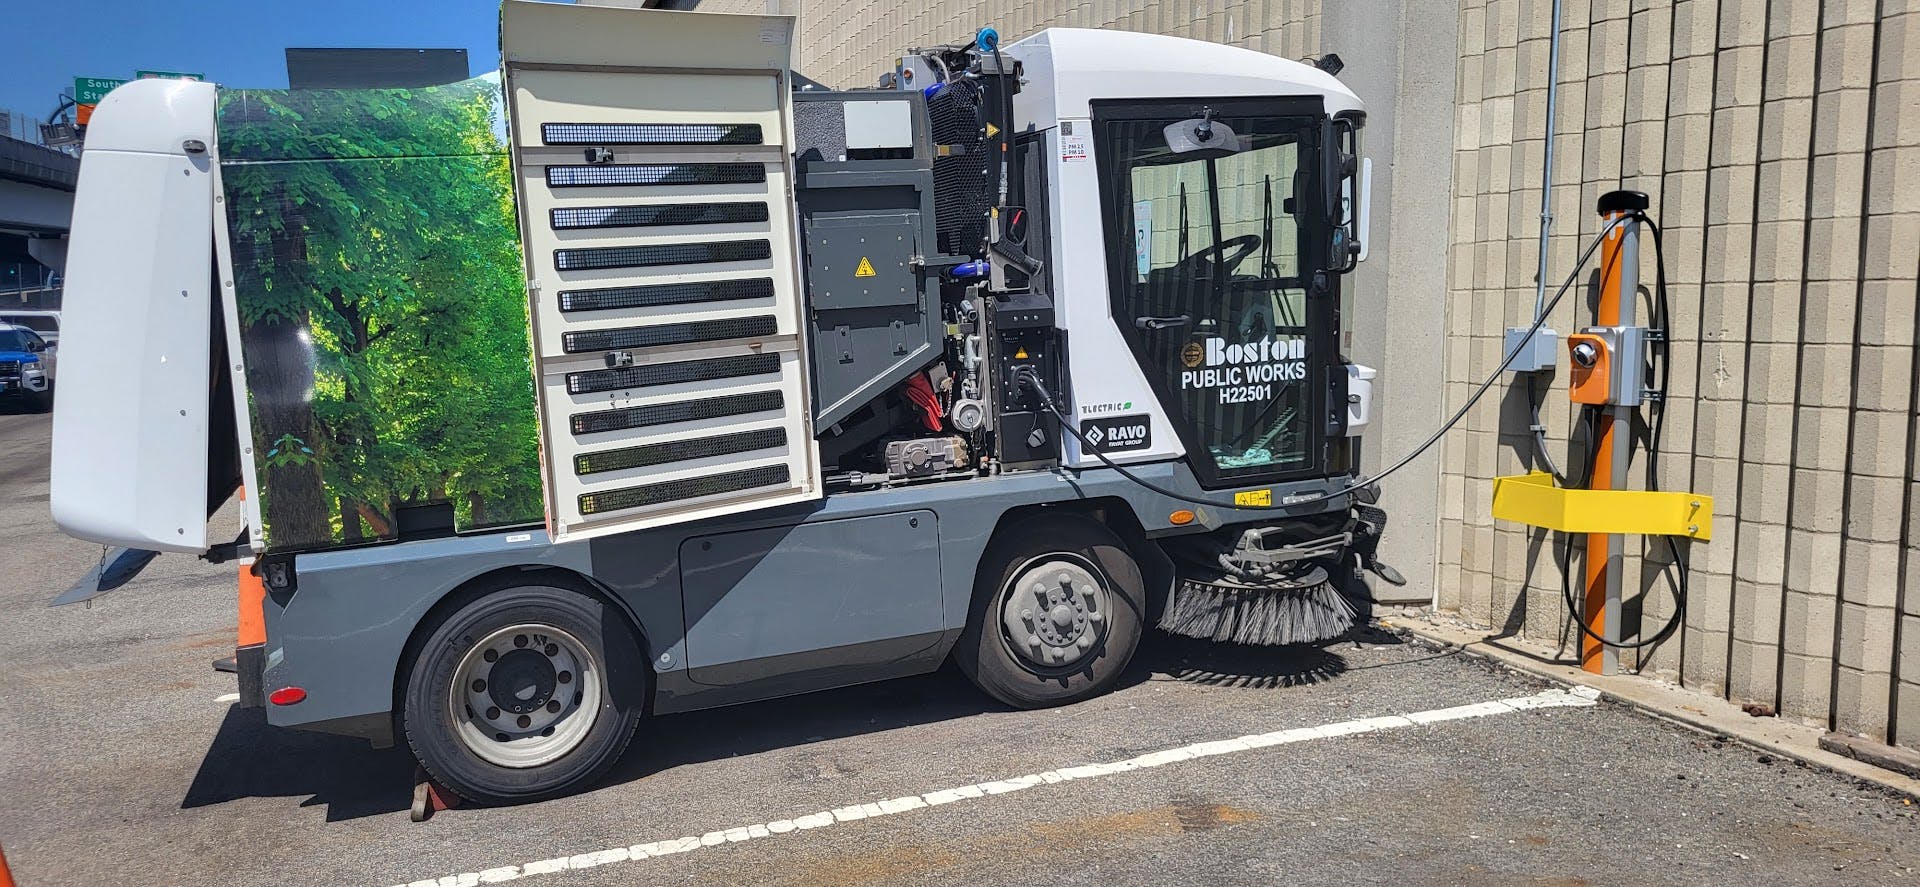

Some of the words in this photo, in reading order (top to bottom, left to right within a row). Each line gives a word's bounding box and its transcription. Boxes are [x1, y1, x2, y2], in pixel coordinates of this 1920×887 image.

[87, 80, 120, 89] South
[83, 91, 108, 100] Sta
[1206, 334, 1305, 366] Boston
[1181, 367, 1242, 390] PUBLIC
[1245, 362, 1306, 383] WORKS
[1219, 384, 1271, 404] H22501
[1081, 403, 1122, 414] ELECTRIC
[1108, 425, 1146, 440] RAVO
